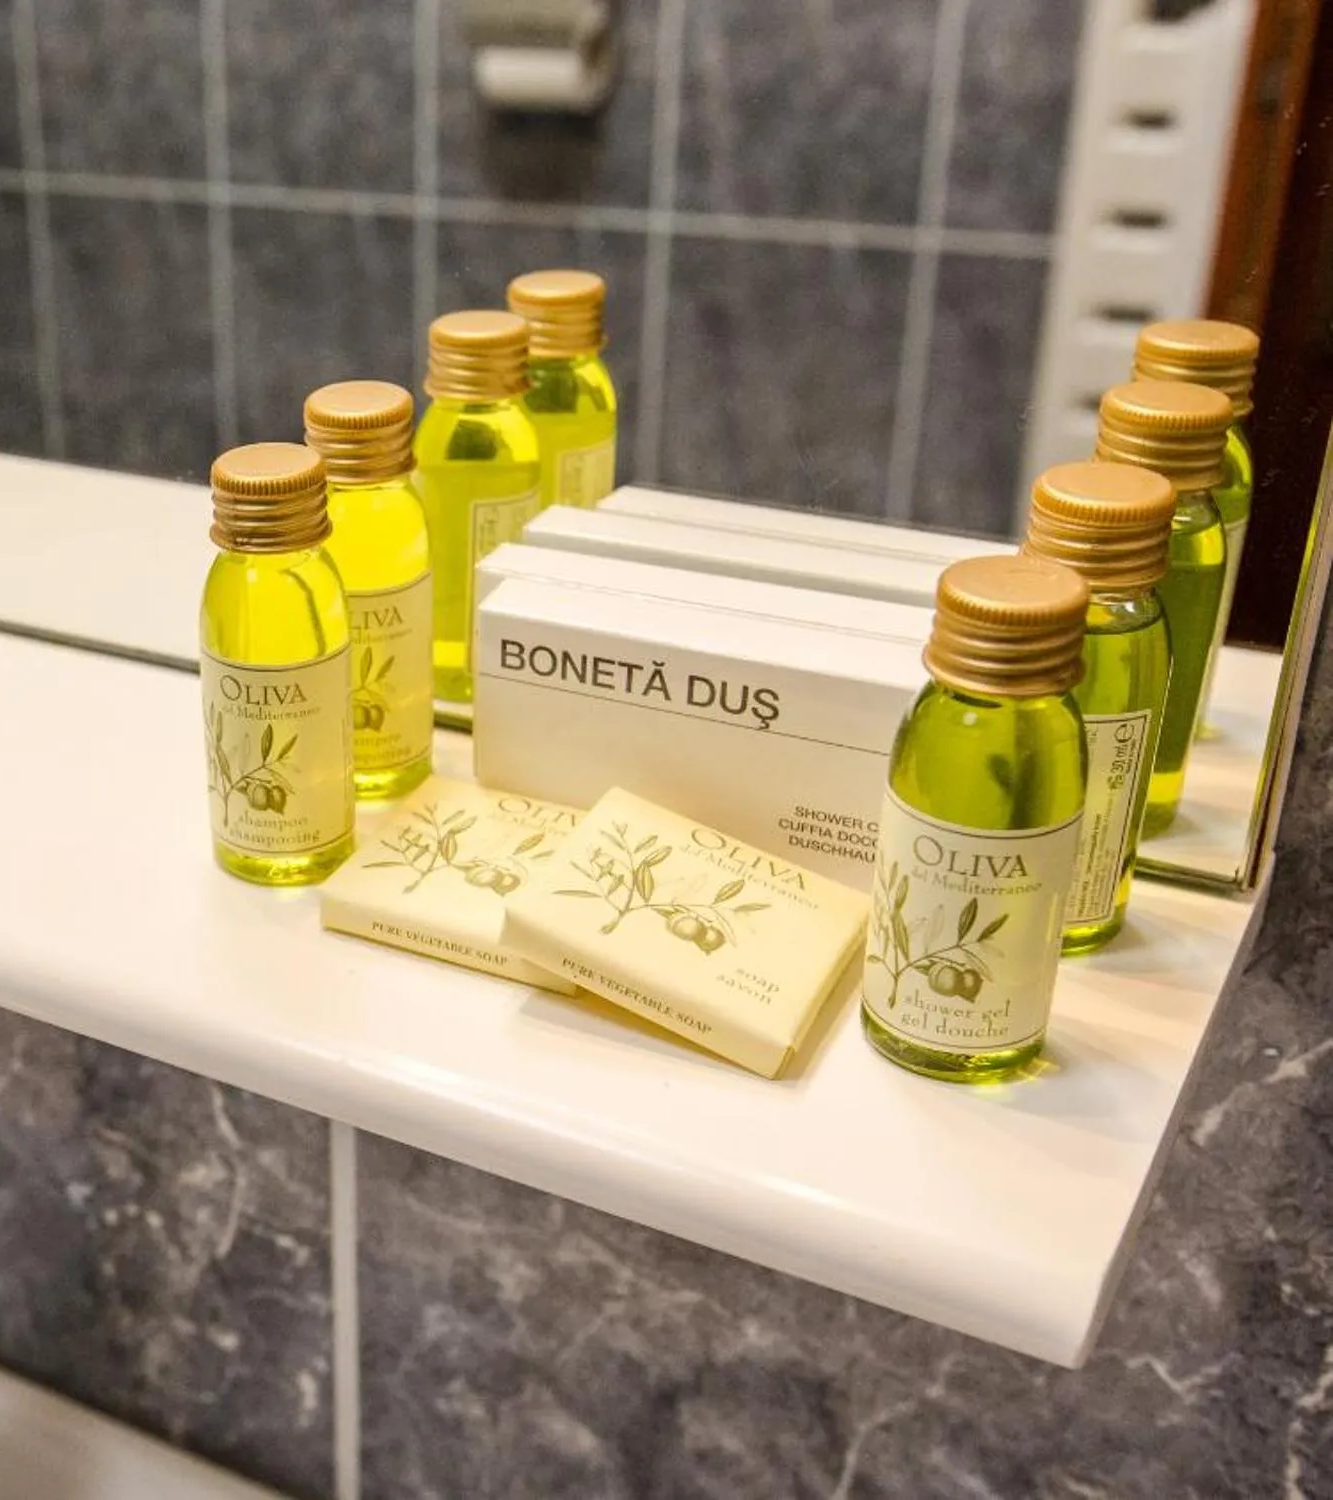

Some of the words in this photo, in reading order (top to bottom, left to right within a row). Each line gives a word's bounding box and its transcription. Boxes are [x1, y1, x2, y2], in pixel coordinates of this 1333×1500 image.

[501, 639, 672, 701] BONETĂ
[220, 674, 308, 706] OLIVA
[238, 809, 308, 833] shampoo
[778, 818, 832, 839] CUFFIA
[794, 806, 863, 830] SHOWER
[691, 828, 806, 890] OLIVA
[789, 835, 875, 863] DUSCHHAU
[913, 834, 1028, 878] OLIVA
[371, 921, 404, 937] PURE
[476, 951, 508, 966] SOAP
[562, 957, 596, 980] PURE
[600, 975, 674, 1017] VEGETABLE
[677, 1010, 713, 1034] SOAP
[905, 989, 975, 1019] shower
[981, 998, 1011, 1023] gel
[936, 1016, 1009, 1038] douche
